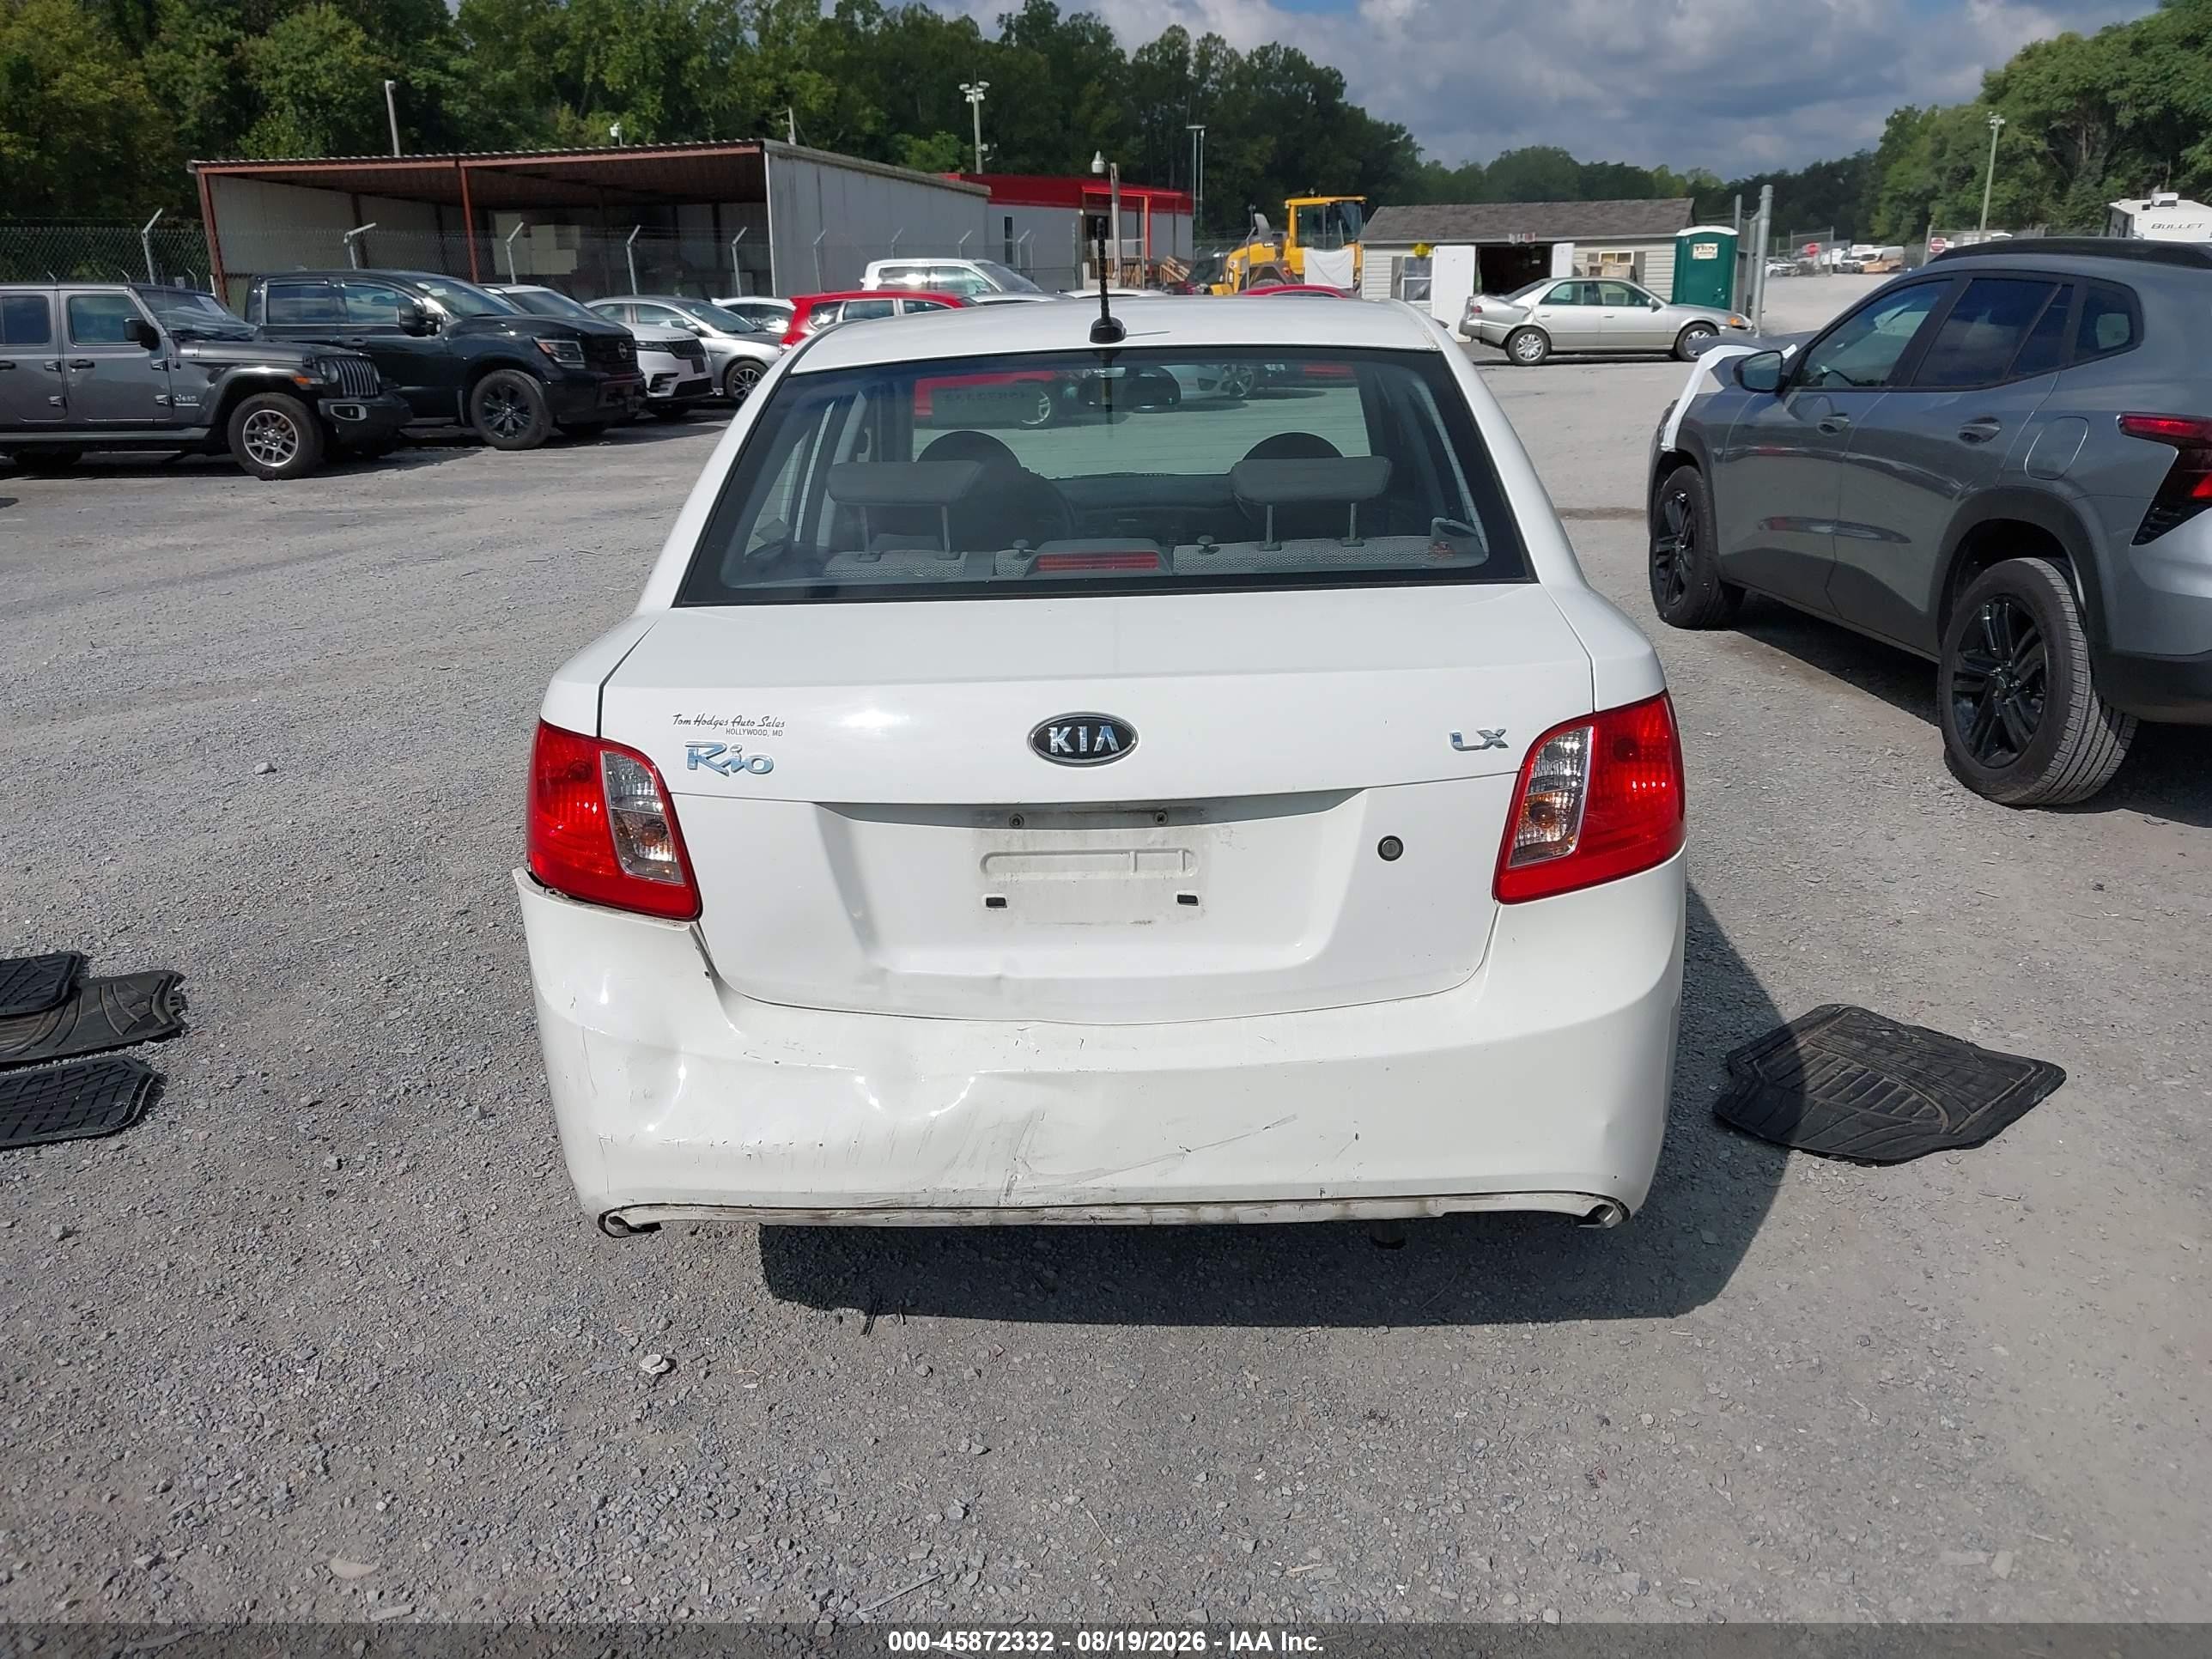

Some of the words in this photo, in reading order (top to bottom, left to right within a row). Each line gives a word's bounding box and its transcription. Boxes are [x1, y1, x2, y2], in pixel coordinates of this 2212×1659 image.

[672, 714, 691, 726] Tom
[693, 713, 728, 730] Hodges
[730, 715, 756, 727] Auto
[757, 716, 786, 728] Sales
[726, 728, 769, 737] HOLLYWOOD,
[1048, 725, 1119, 753] KIA
[1449, 727, 1510, 751] LX
[684, 741, 775, 776] Rio
